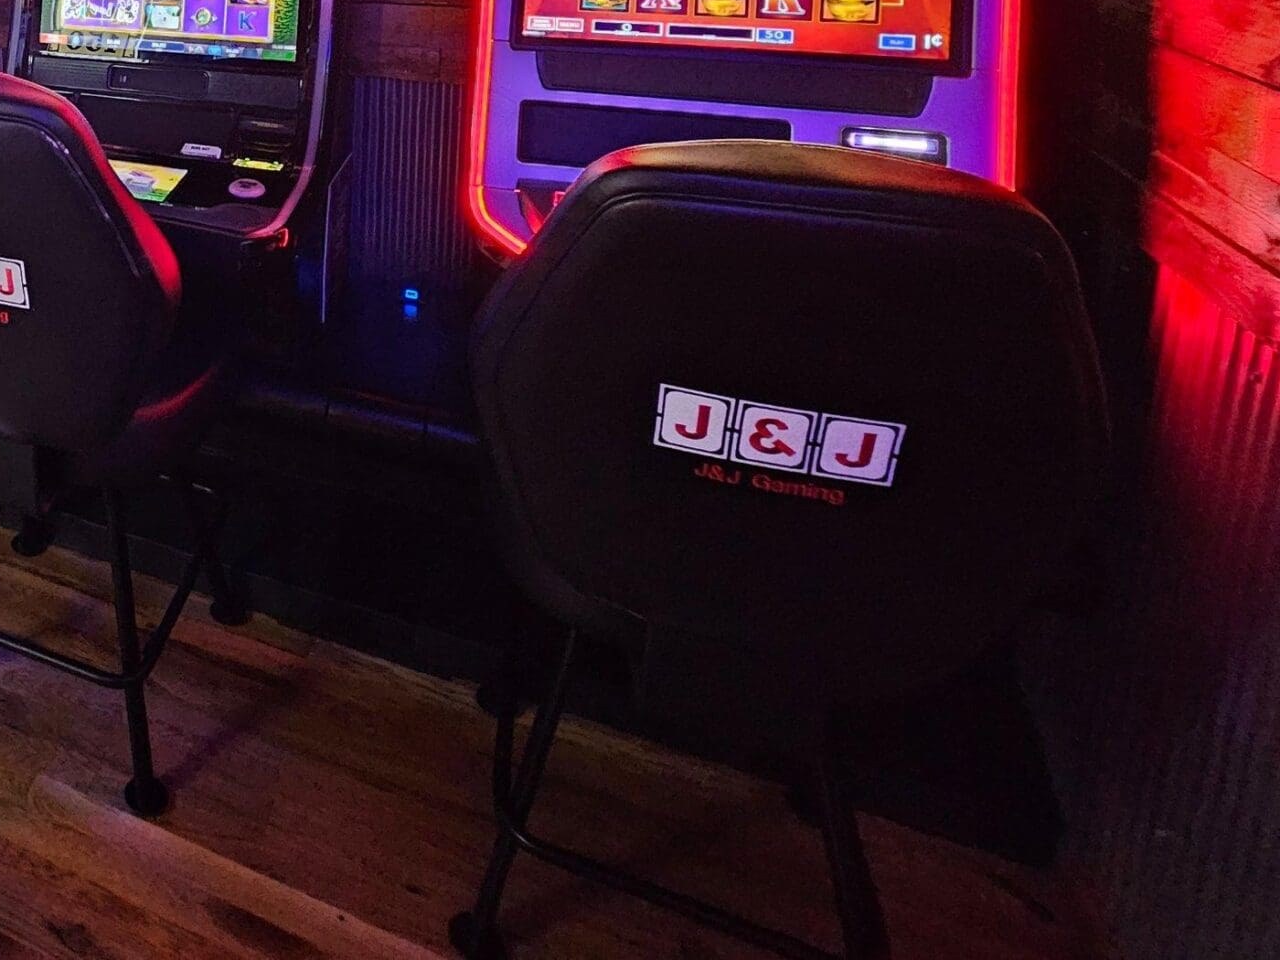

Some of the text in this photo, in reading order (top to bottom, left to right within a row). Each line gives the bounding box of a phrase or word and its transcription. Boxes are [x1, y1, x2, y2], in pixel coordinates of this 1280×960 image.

[238, 11, 256, 32] K
[765, 30, 785, 40] 50
[923, 33, 943, 50] 1¢
[693, 462, 845, 506] J&J Gaming
